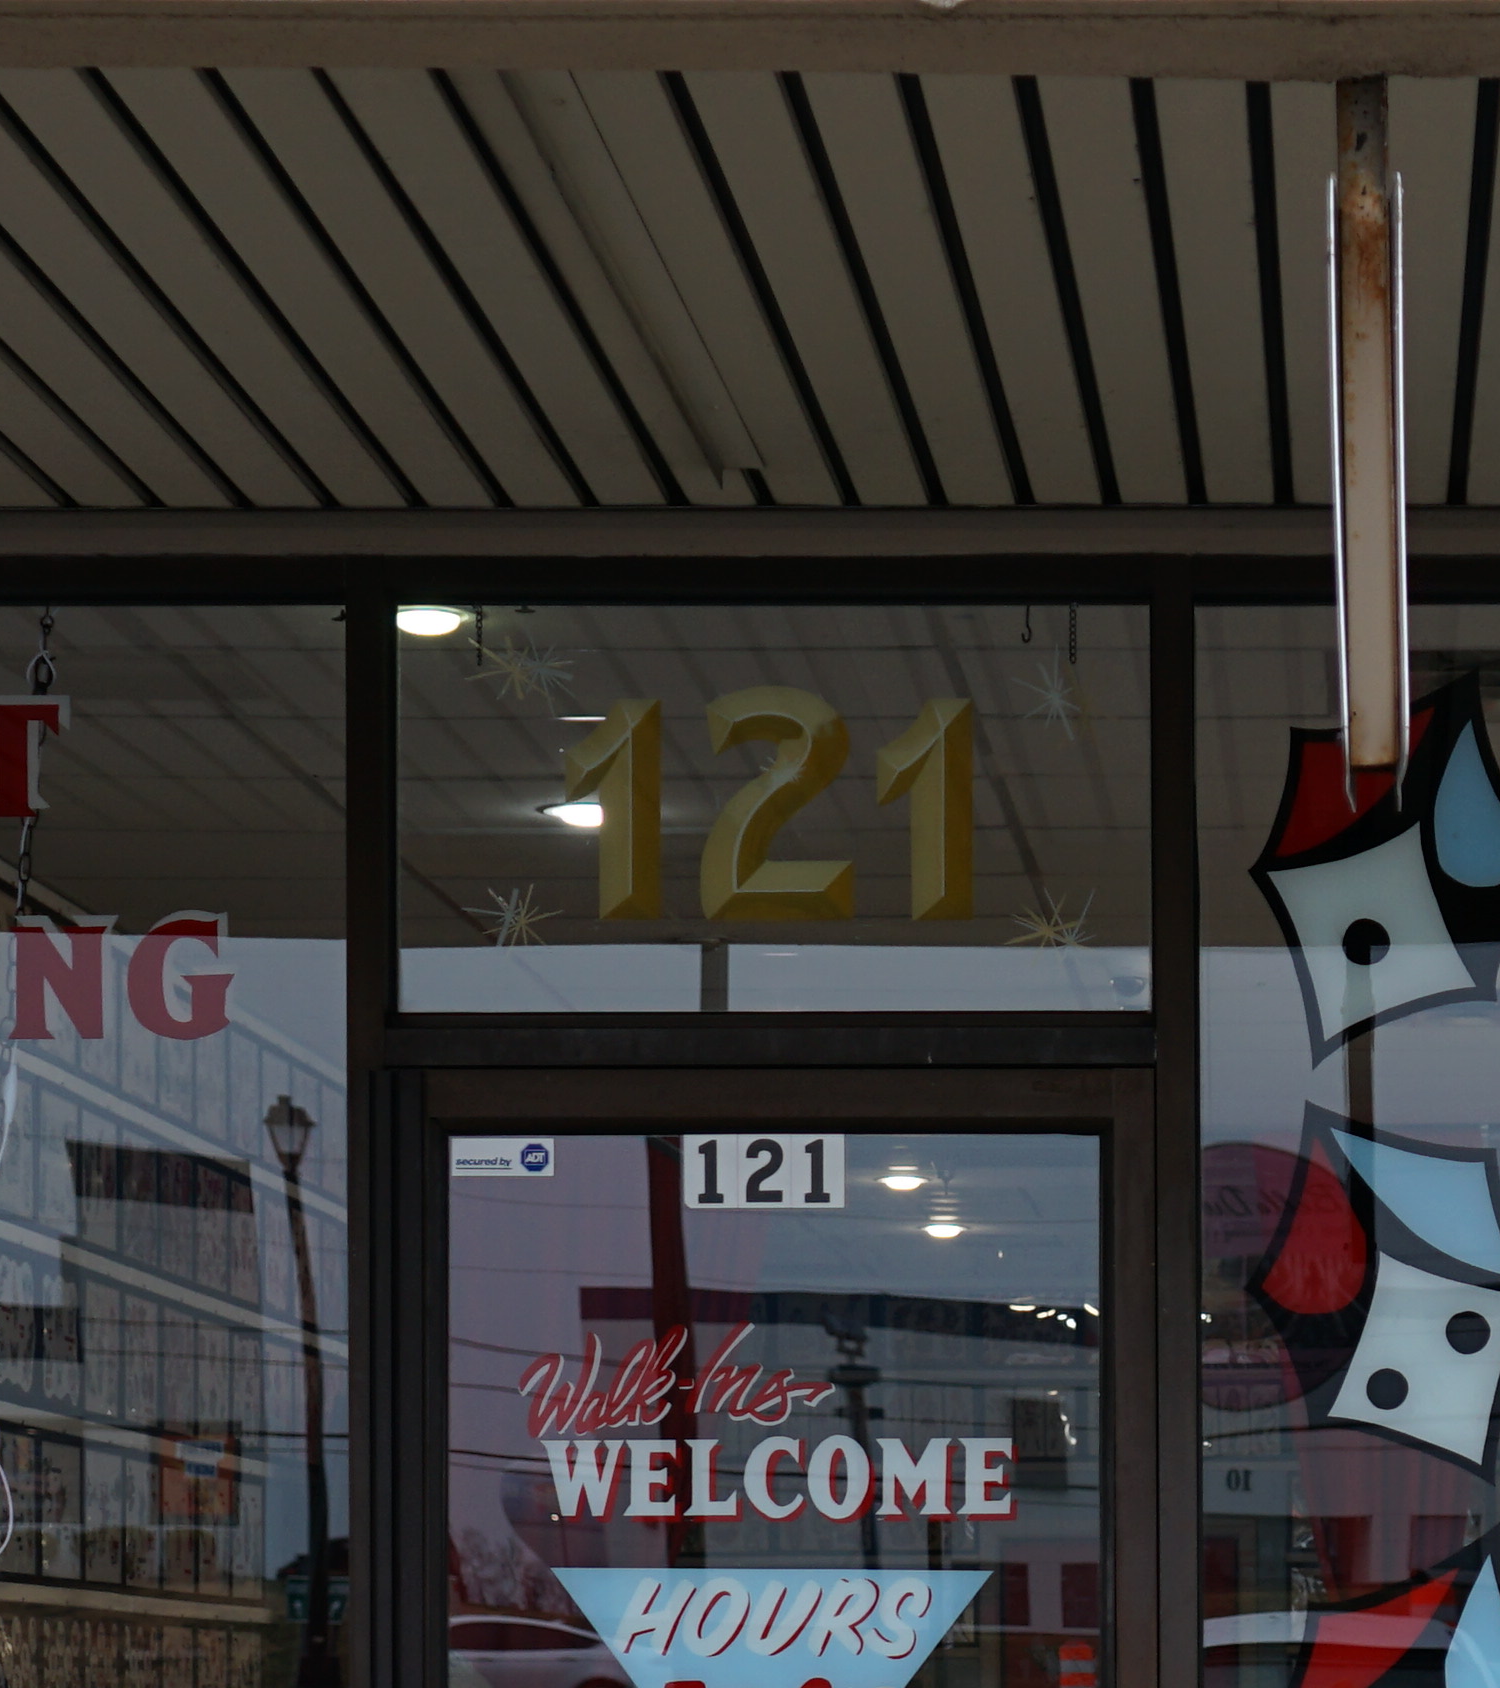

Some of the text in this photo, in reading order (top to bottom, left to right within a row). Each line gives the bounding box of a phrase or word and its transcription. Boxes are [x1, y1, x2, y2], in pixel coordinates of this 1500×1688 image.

[563, 685, 974, 921] 121
[455, 1151, 546, 1167] secured by ADT
[697, 1138, 832, 1205] 121
[540, 1434, 1018, 1524] WELCOME
[618, 1575, 933, 1659] HOURS
